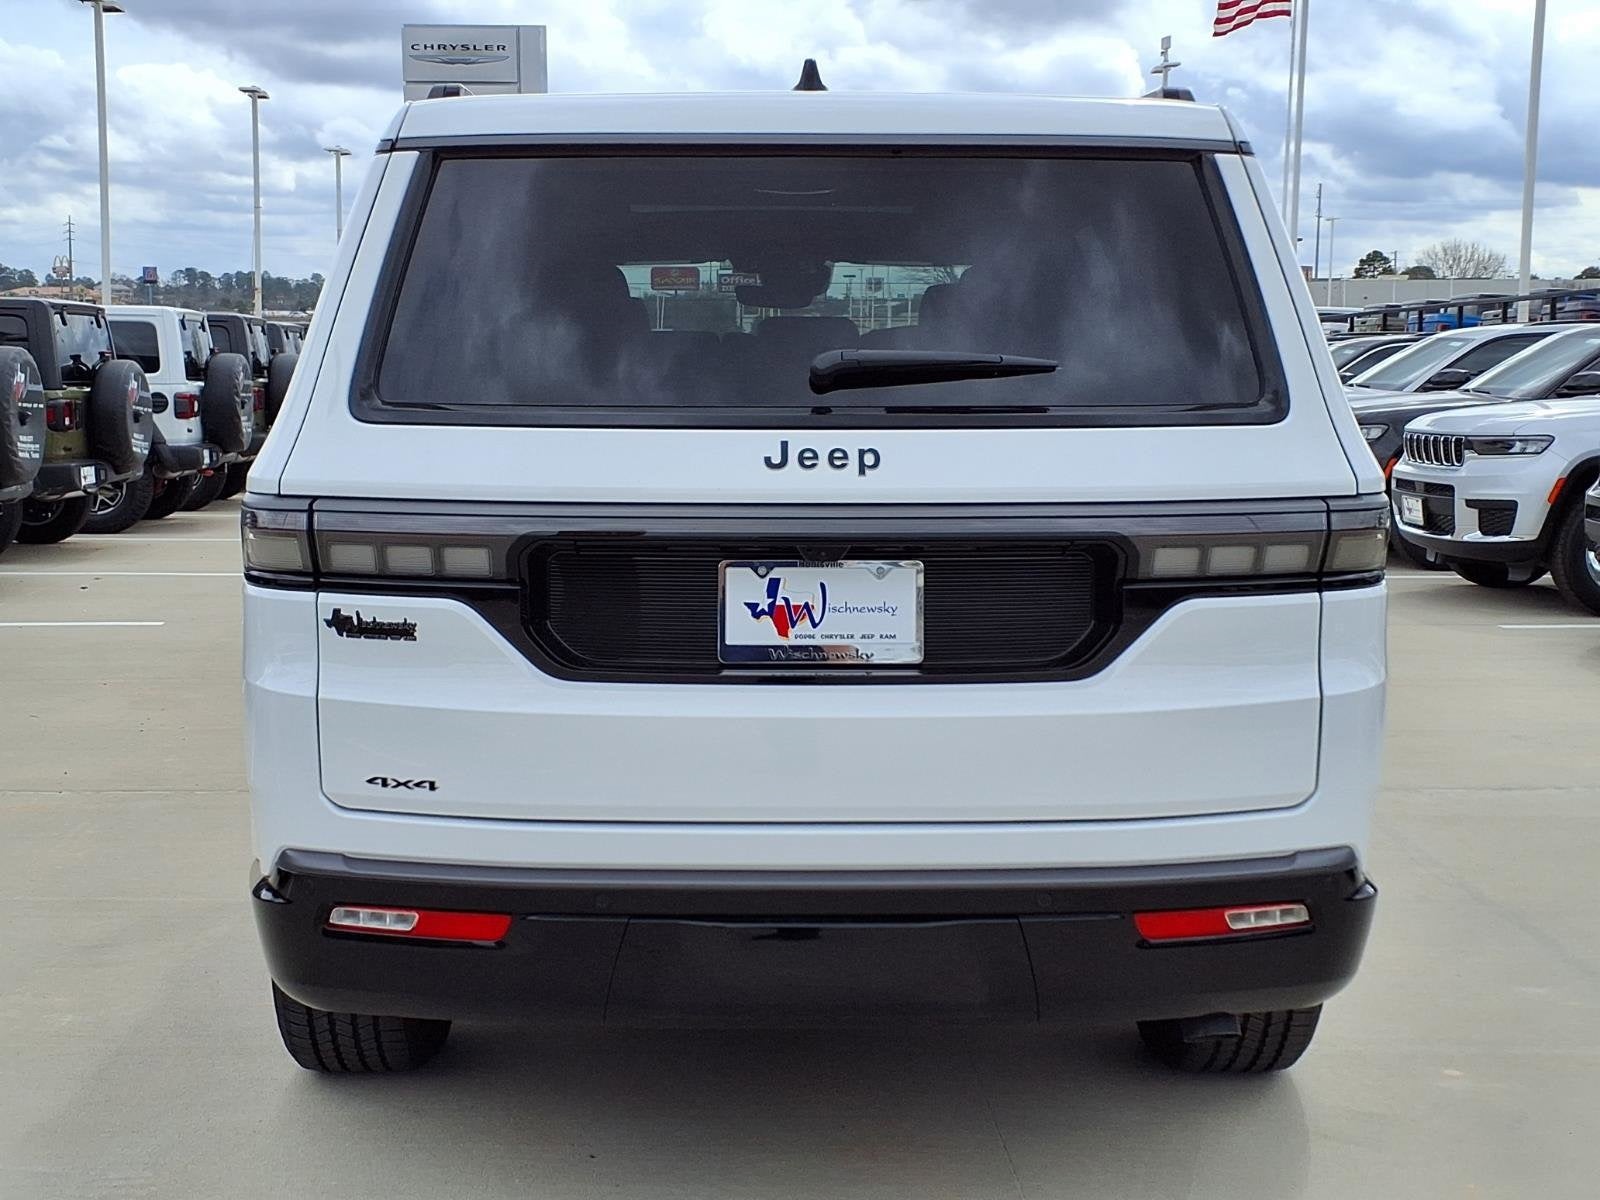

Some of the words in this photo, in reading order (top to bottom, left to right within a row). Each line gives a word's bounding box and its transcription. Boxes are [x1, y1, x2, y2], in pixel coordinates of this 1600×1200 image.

[410, 43, 507, 52] CHRYSLER
[720, 275, 754, 285] Office
[763, 440, 881, 476] Jeep
[781, 581, 898, 629] Wischnewsky
